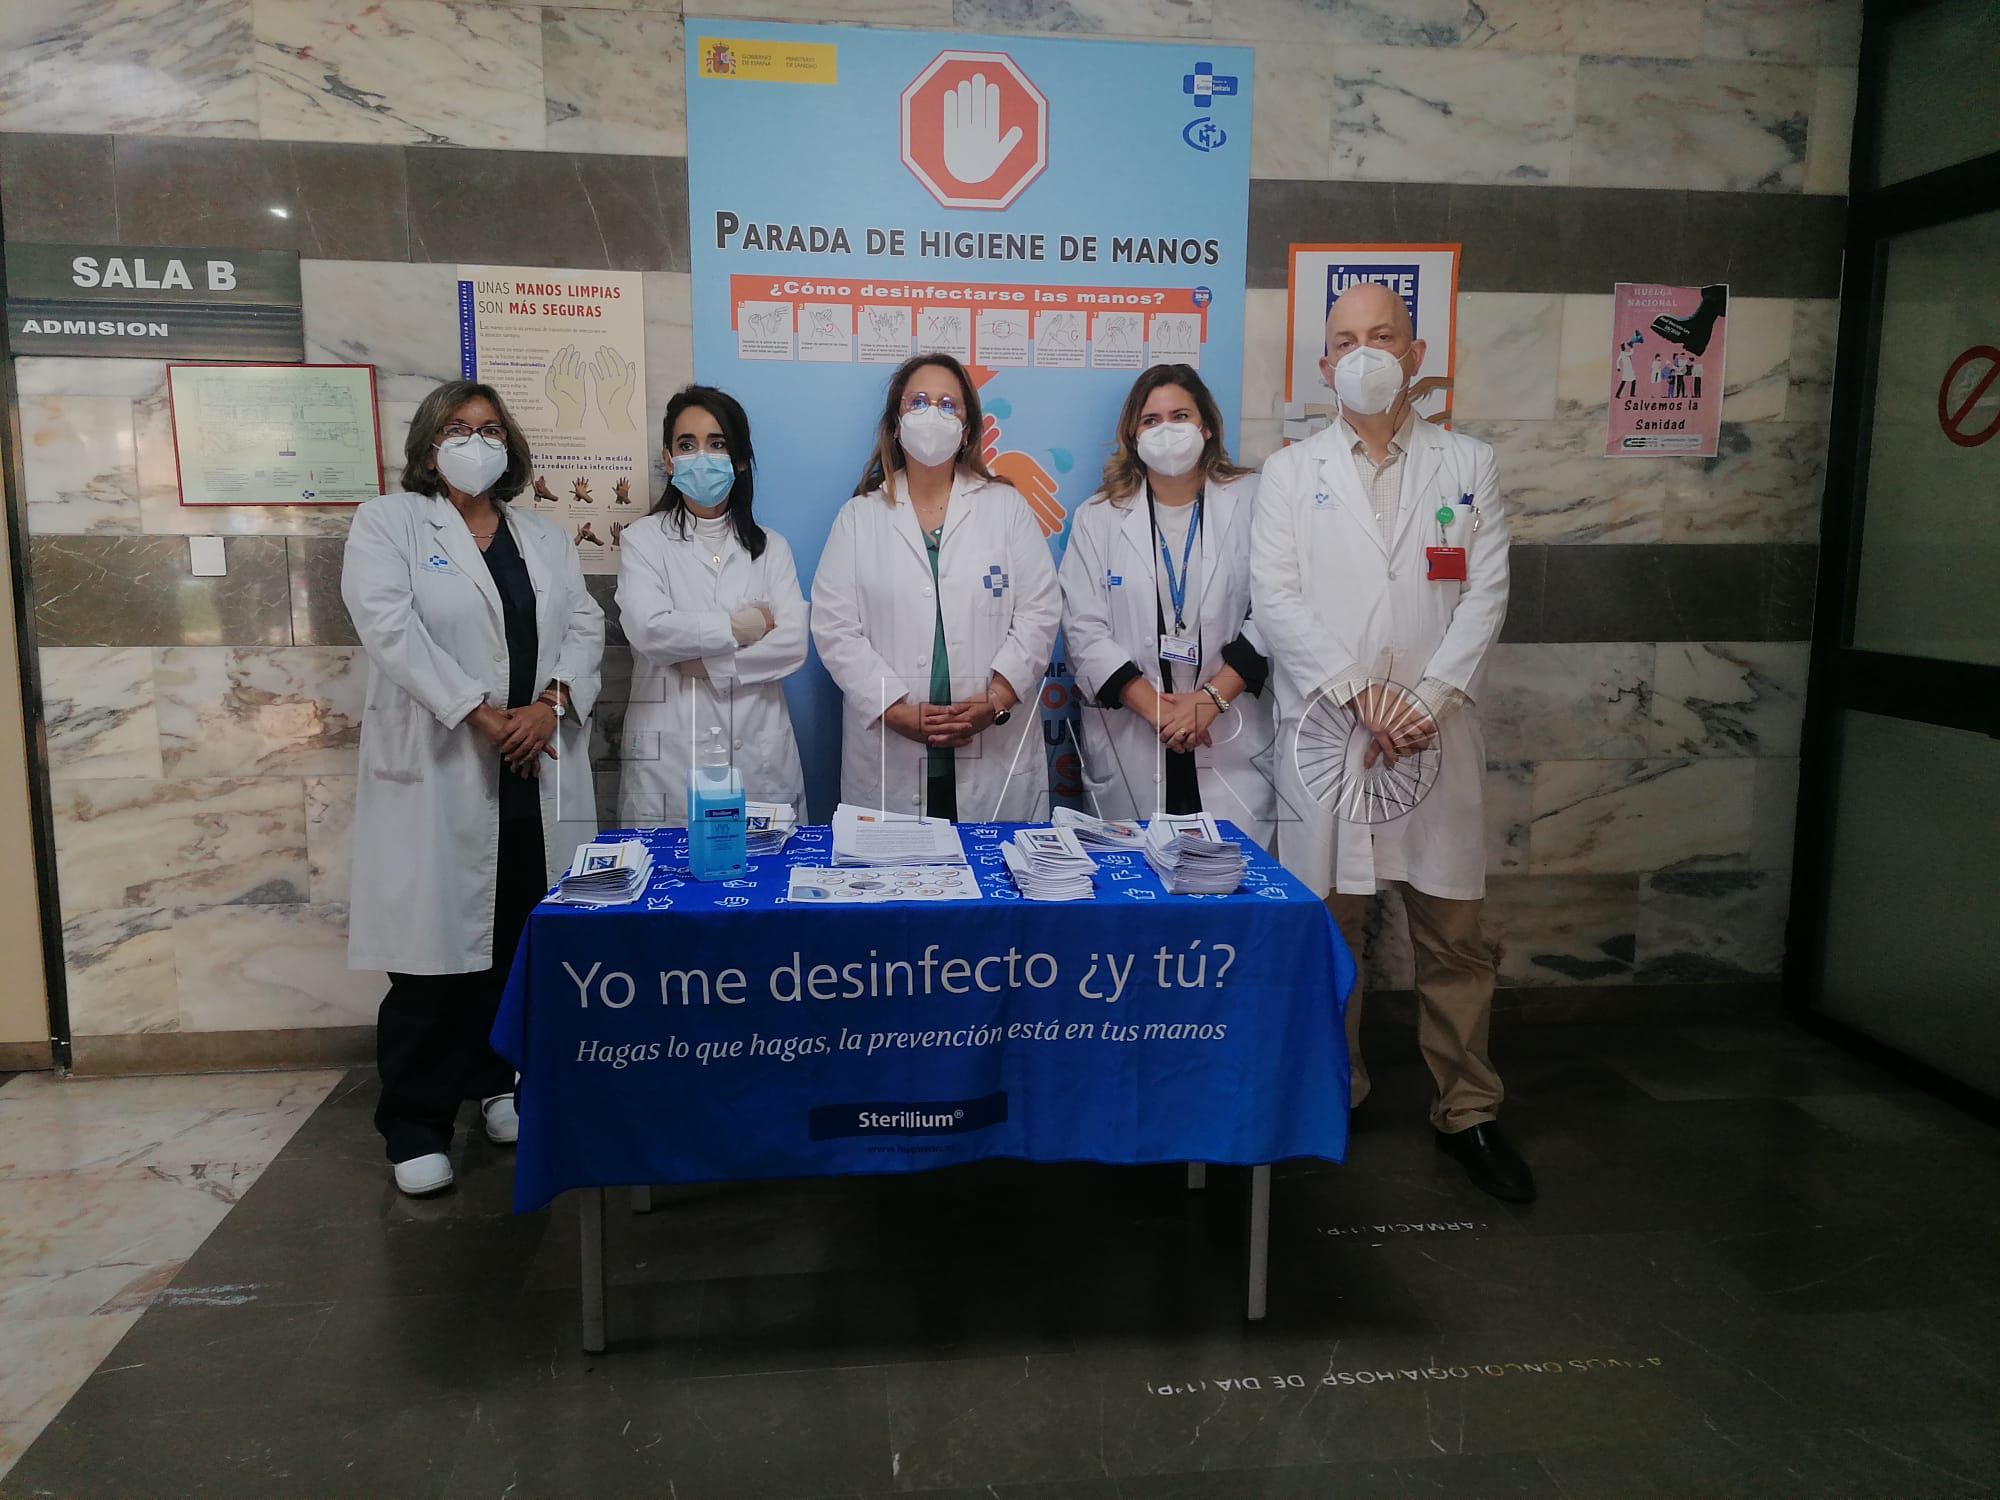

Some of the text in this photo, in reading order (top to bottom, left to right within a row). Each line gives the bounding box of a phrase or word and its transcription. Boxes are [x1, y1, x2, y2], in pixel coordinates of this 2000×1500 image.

[715, 211, 1219, 265] PARADA DE HIGIENE DE MANOS
[72, 256, 237, 291] SALA B
[477, 281, 621, 299] UNAS MANOS LIMPIAS
[770, 281, 1165, 305] ¿Cómo desinfectarse las manos?
[1634, 287, 1673, 296] HUELGA
[478, 300, 602, 318] SON MÁS SEGURAS
[1627, 299, 1678, 307] NACIONAL
[22, 319, 168, 337] ADMISION
[1624, 399, 1699, 411] Salvemos la
[1635, 419, 1686, 430] Sanidad
[561, 939, 1237, 1009] Yo me desinfecto ¿y tú?
[575, 1018, 1227, 1069] Hagas lo que hagas, la prevención está en tus manos
[1374, 1221, 1488, 1234] ARMACIA
[1216, 1376, 1262, 1391] DIA
[1272, 1374, 1306, 1390] DE
